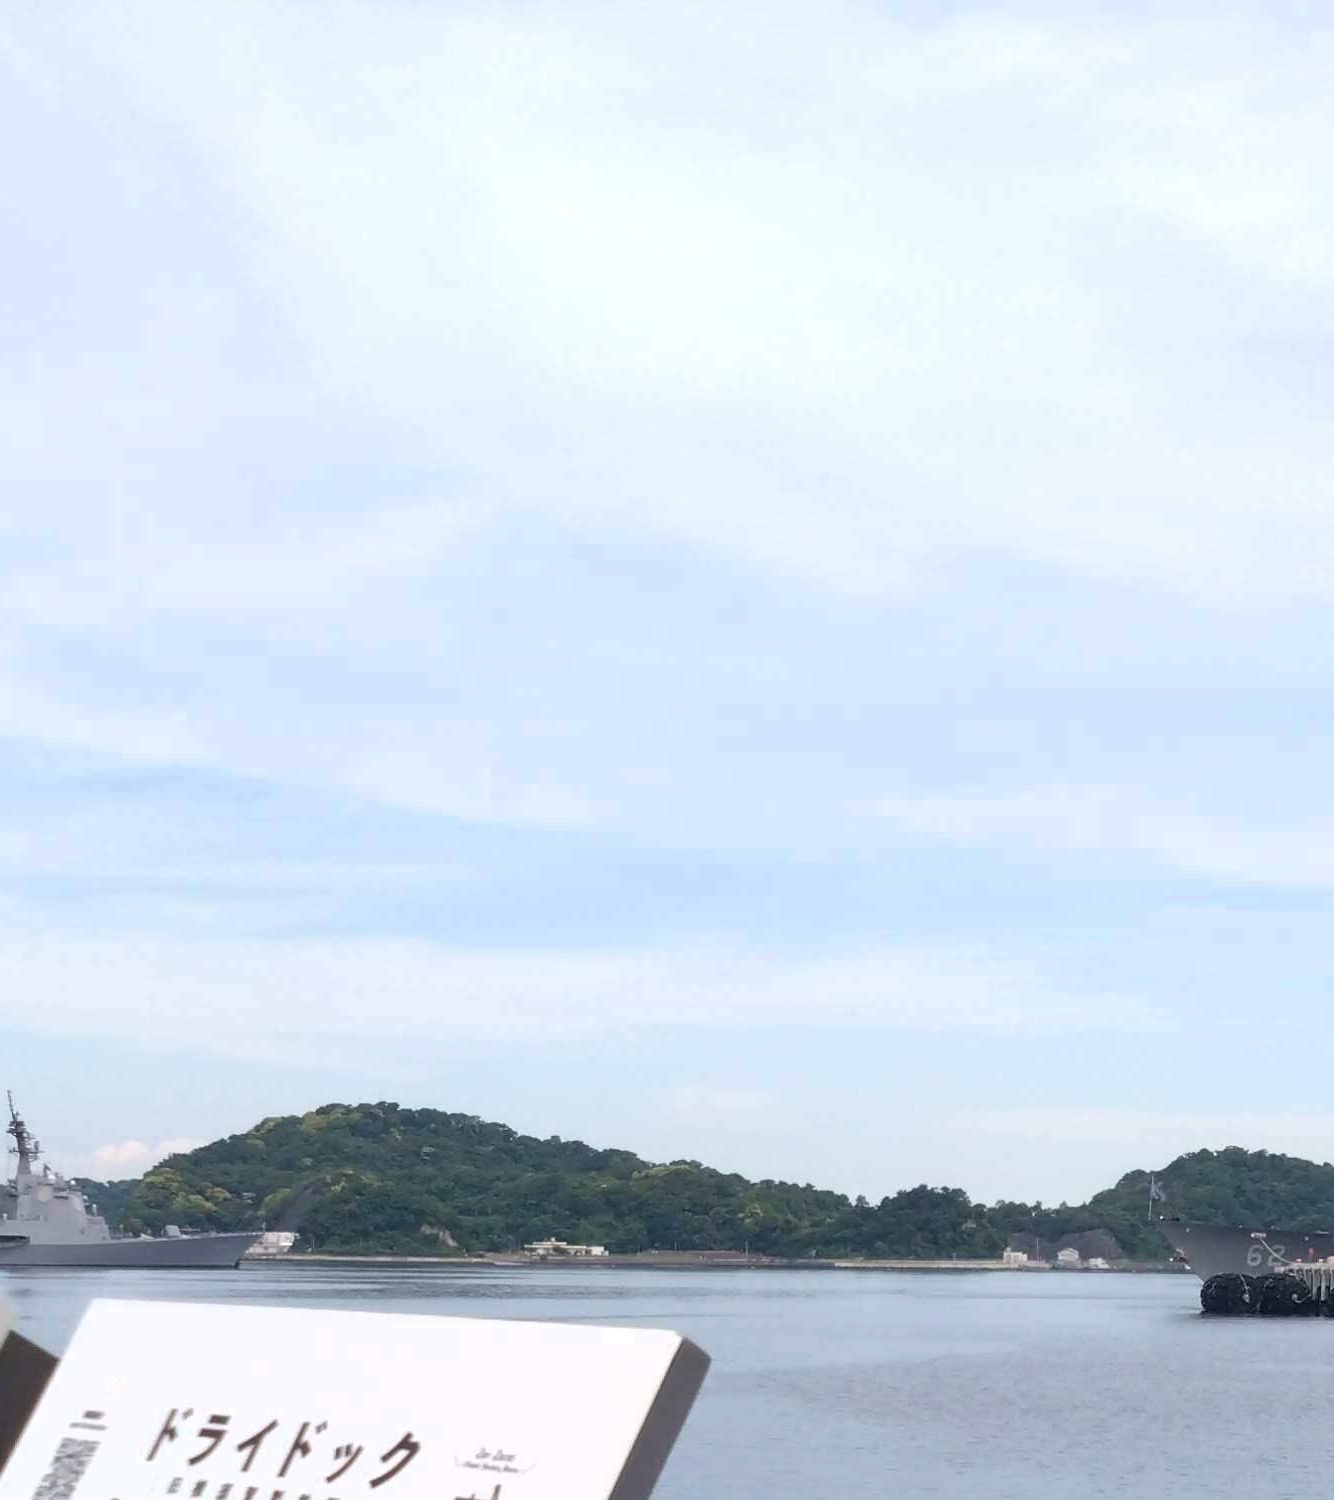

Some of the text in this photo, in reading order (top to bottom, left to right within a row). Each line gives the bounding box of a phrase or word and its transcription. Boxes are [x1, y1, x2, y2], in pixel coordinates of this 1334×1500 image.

[1247, 1244, 1286, 1266] 62
[145, 1406, 421, 1490] ドライドック
